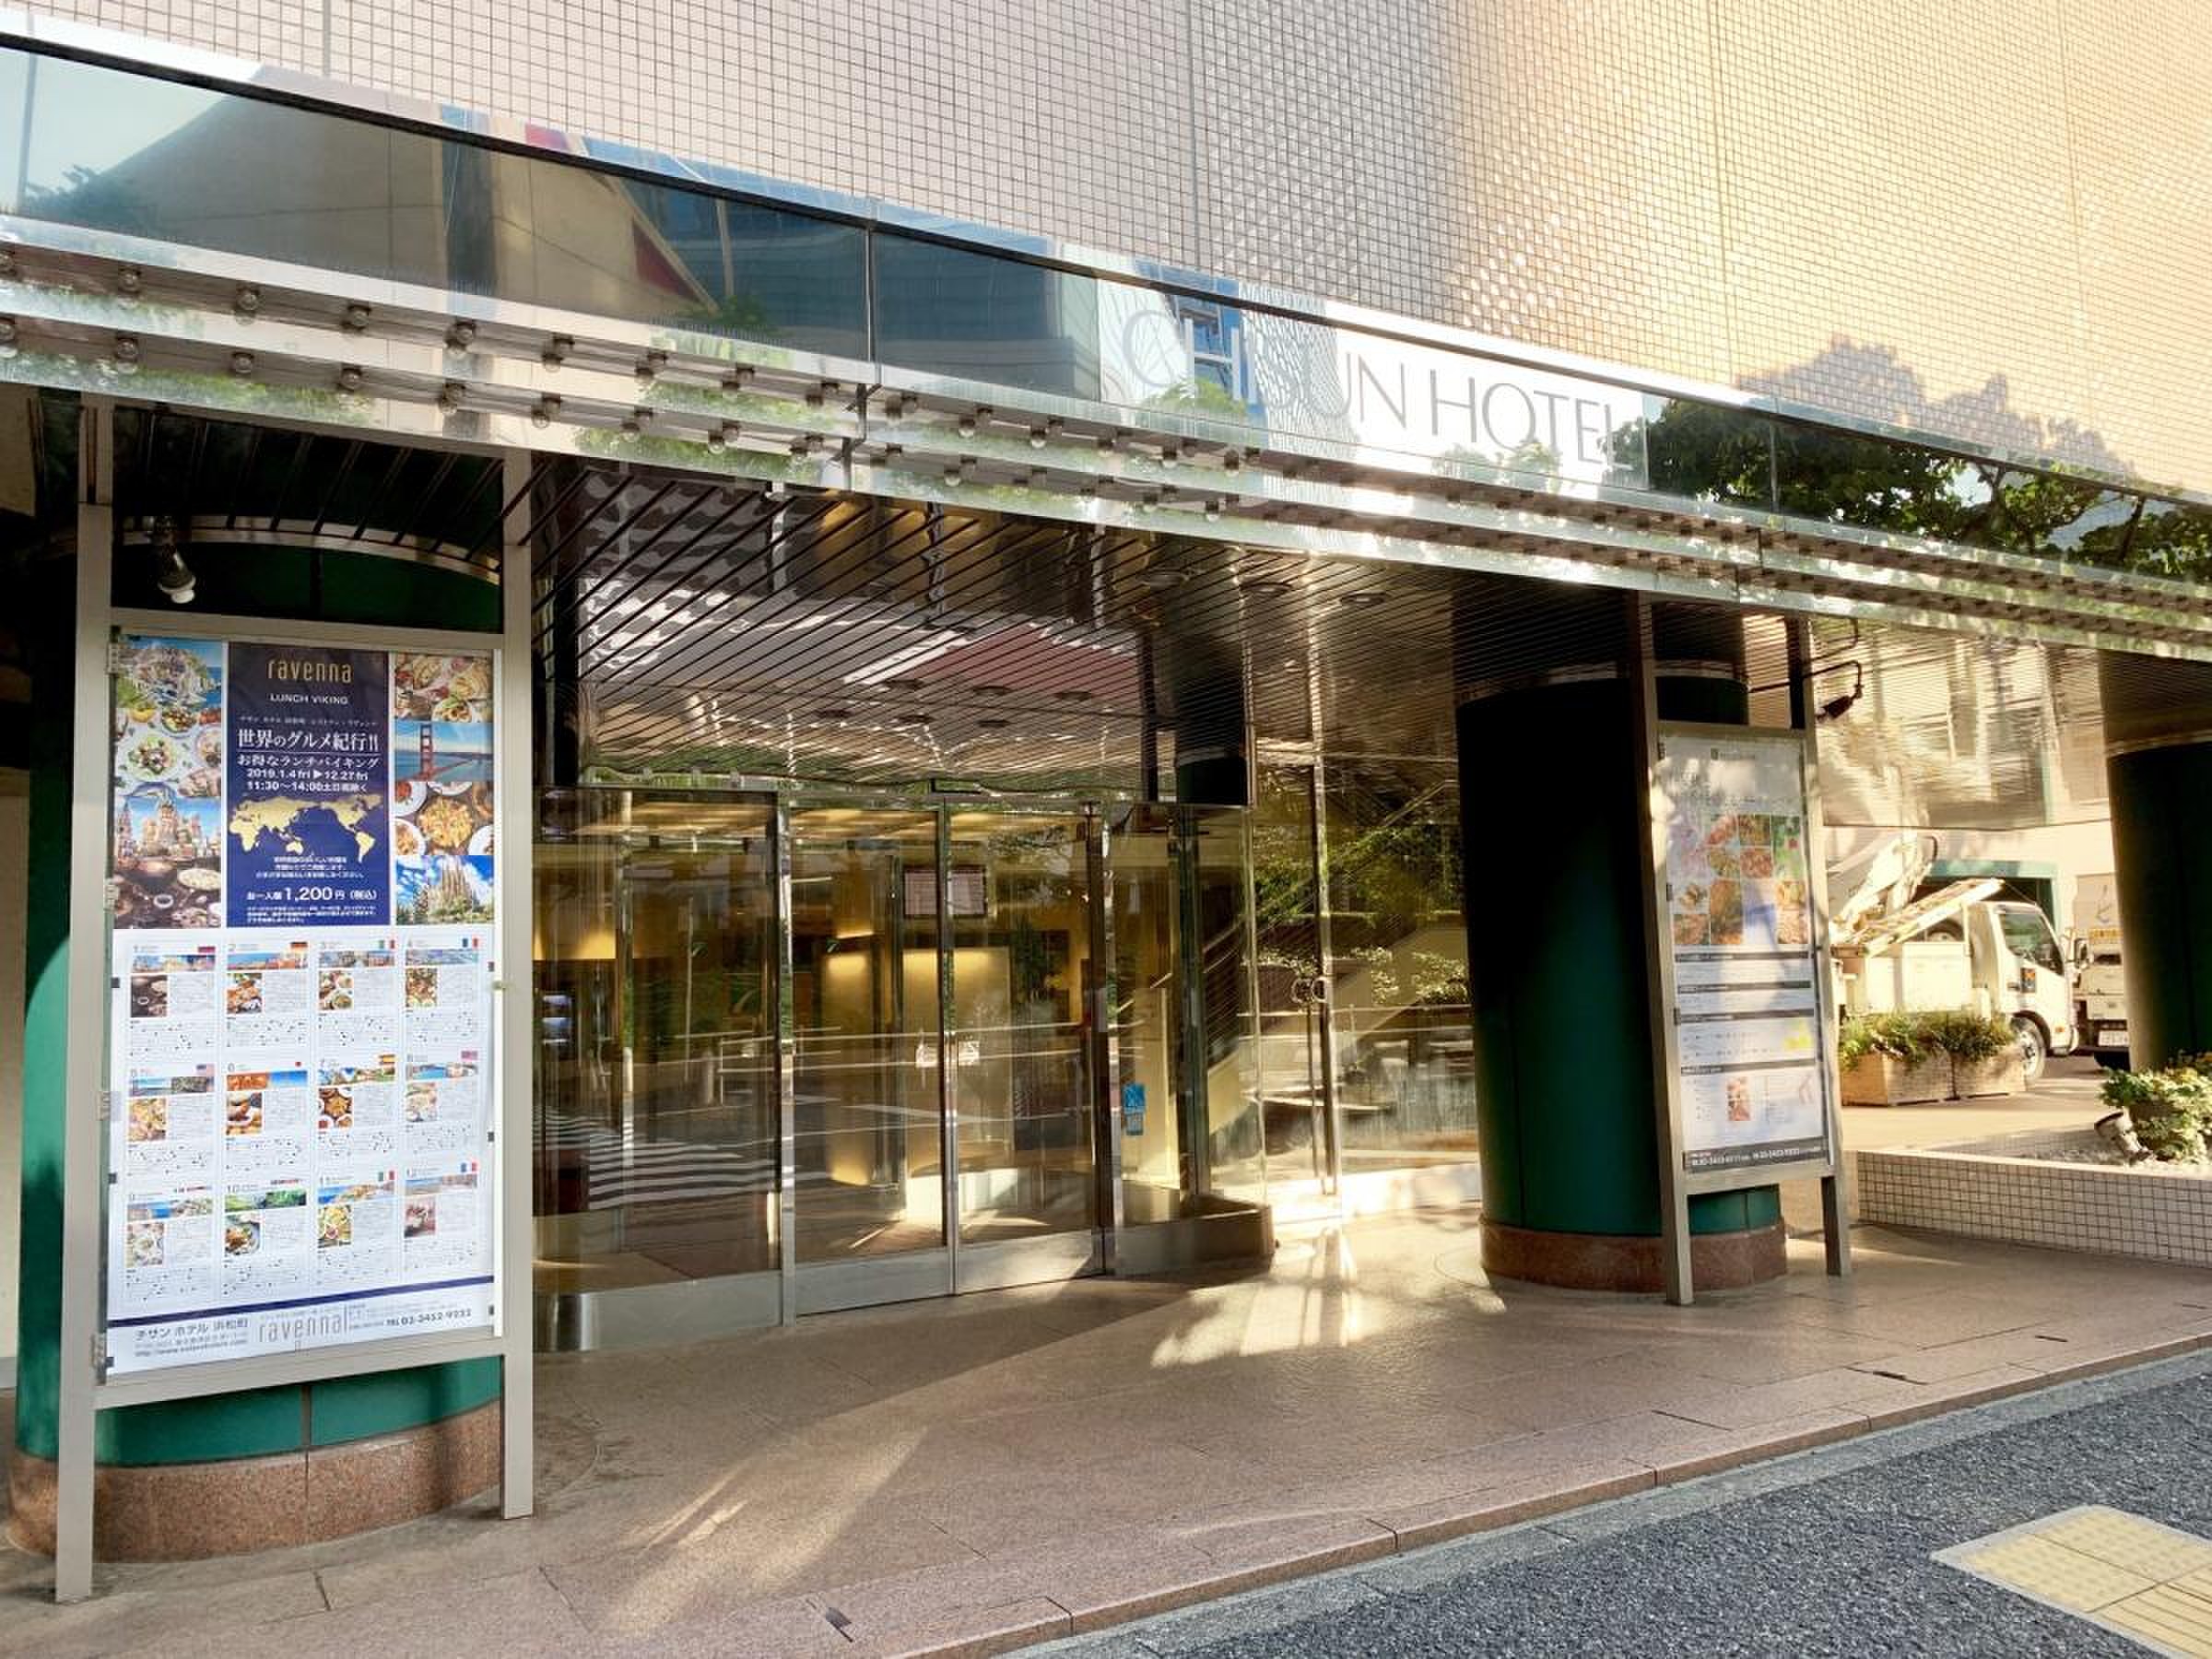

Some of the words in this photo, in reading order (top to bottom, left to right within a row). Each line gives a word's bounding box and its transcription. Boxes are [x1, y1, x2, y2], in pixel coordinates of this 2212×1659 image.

[1430, 368, 1633, 473] HOTEL
[267, 659, 352, 684] ravenna
[270, 693, 309, 703] LUNCH
[312, 694, 349, 705] VIKING
[237, 754, 380, 769] お得なランチバイキング
[259, 1312, 342, 1343] ravenna
